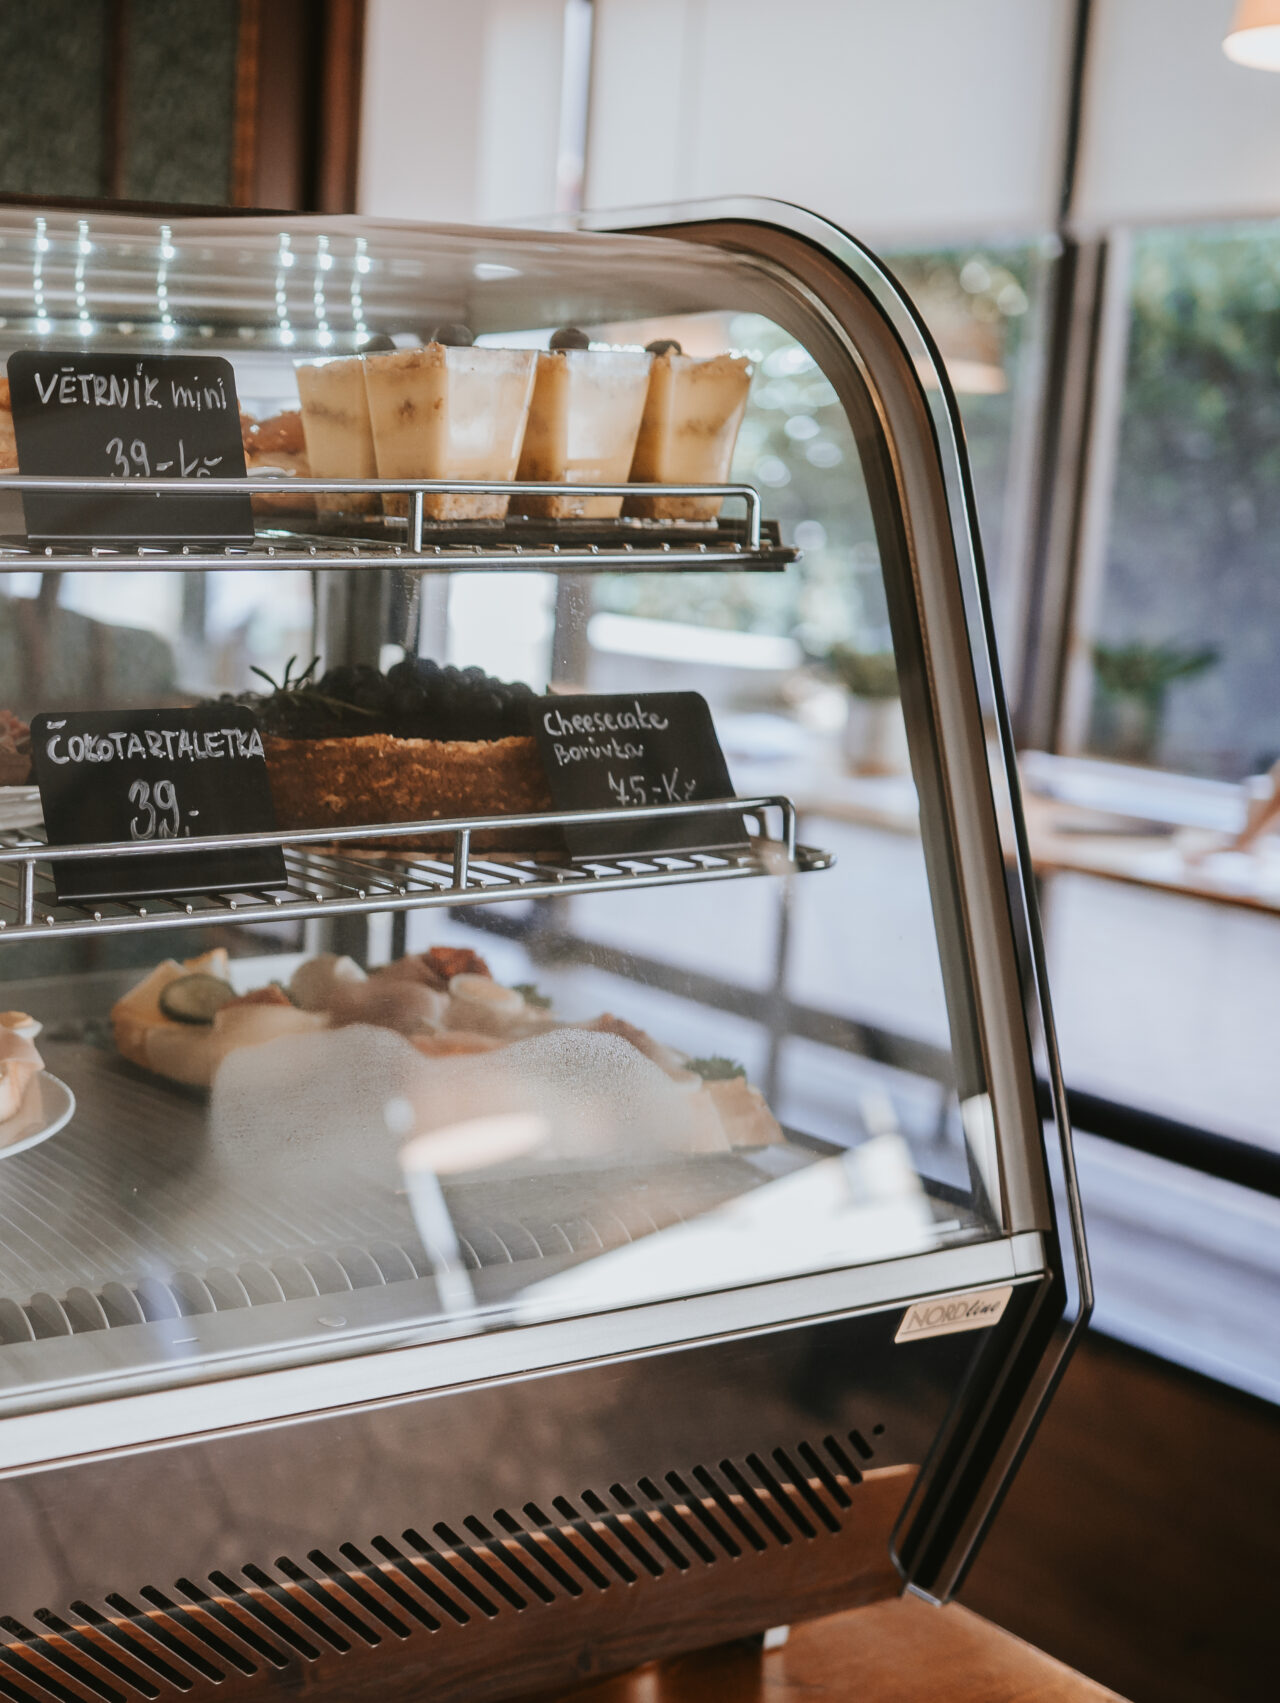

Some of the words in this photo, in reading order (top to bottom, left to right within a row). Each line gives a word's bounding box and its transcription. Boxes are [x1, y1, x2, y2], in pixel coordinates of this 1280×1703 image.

[171, 375, 227, 412] mini
[543, 700, 669, 736] Cheesecake
[46, 719, 266, 765] ČOKOTARTALETKA
[906, 1299, 1002, 1330] NORDline
